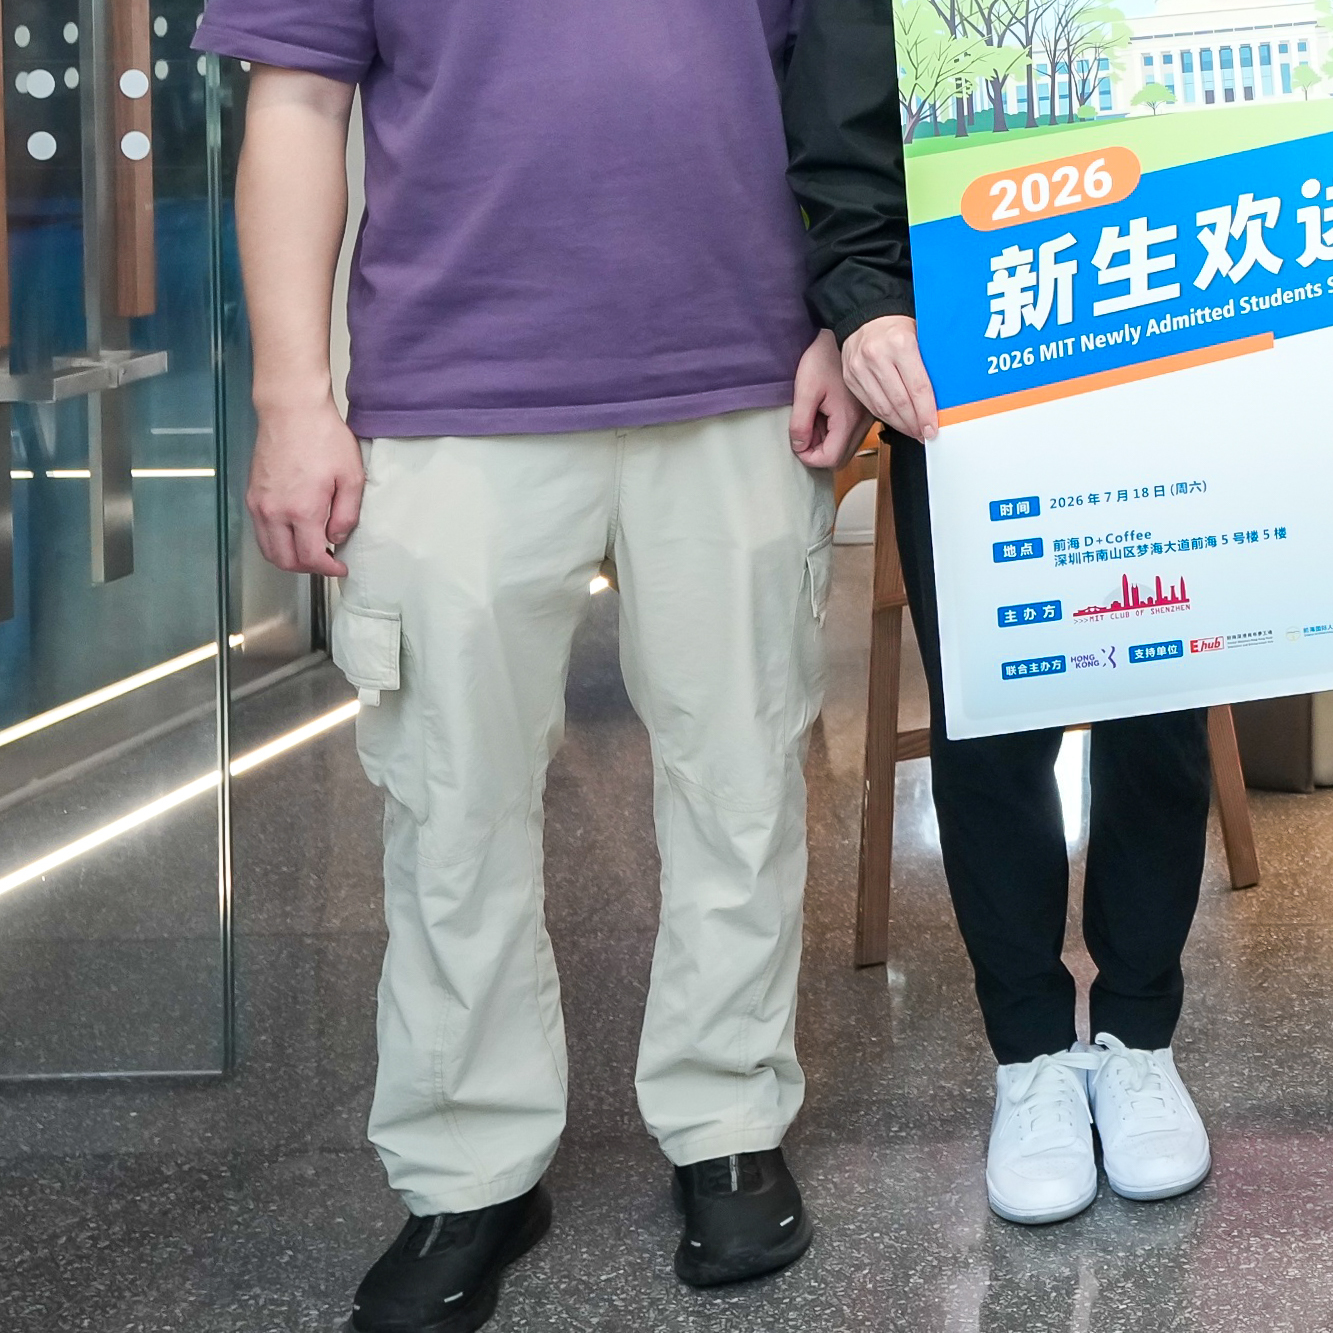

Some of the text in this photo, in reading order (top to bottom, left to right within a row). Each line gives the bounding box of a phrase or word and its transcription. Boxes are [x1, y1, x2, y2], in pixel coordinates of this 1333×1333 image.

[989, 158, 1115, 222] 2026
[986, 346, 1036, 376] 2026
[1039, 336, 1076, 362] MIT
[1080, 323, 1143, 355] Newly
[1145, 298, 1235, 338] Admitted
[1239, 278, 1324, 316] Students
[1049, 494, 1084, 510] 2026
[1169, 480, 1208, 497] (周六)
[1000, 501, 1031, 517] 时间
[1053, 528, 1152, 553] 前海 D+Coffee
[1002, 542, 1034, 558] 地点
[1004, 604, 1058, 624] 主办方
[1110, 610, 1131, 621] CLUB
[1135, 608, 1146, 618] OF
[1150, 603, 1191, 616] SHENZHEN
[1071, 654, 1095, 664] HONG
[1134, 644, 1179, 660] 支持单位
[1005, 659, 1063, 677] 联合主办方
[1075, 659, 1100, 669] KONG
